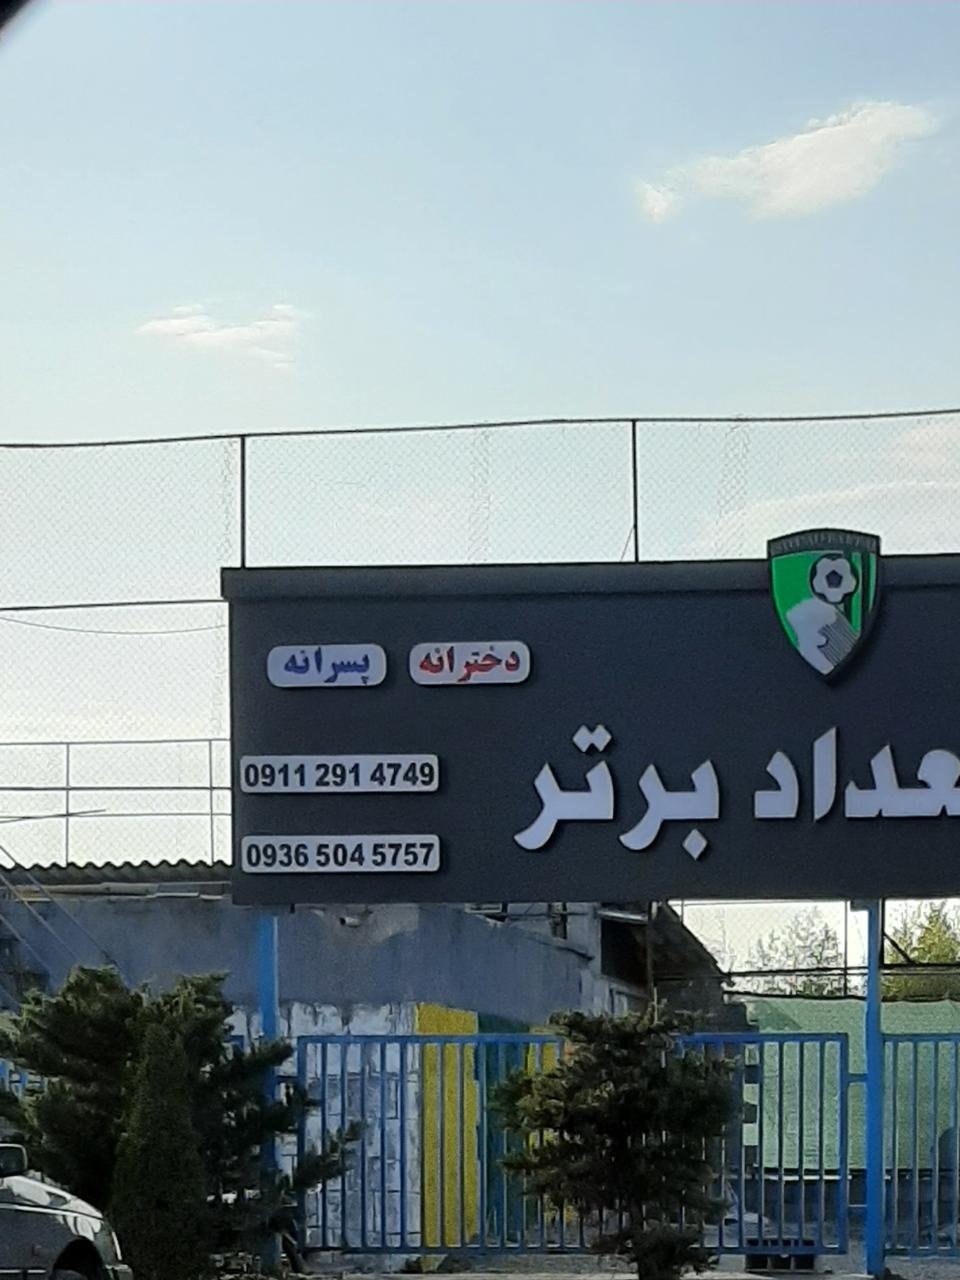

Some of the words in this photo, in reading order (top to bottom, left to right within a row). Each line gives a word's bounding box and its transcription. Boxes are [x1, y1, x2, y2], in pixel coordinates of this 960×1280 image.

[283, 646, 371, 686] پسرانه
[419, 645, 521, 683] دخترانه
[244, 763, 306, 788] 0911
[315, 762, 360, 788] 291
[369, 761, 435, 787] 4749
[513, 723, 720, 860] برتر
[246, 843, 310, 868] 0936
[316, 842, 365, 867] 504
[372, 842, 435, 867] 5757
